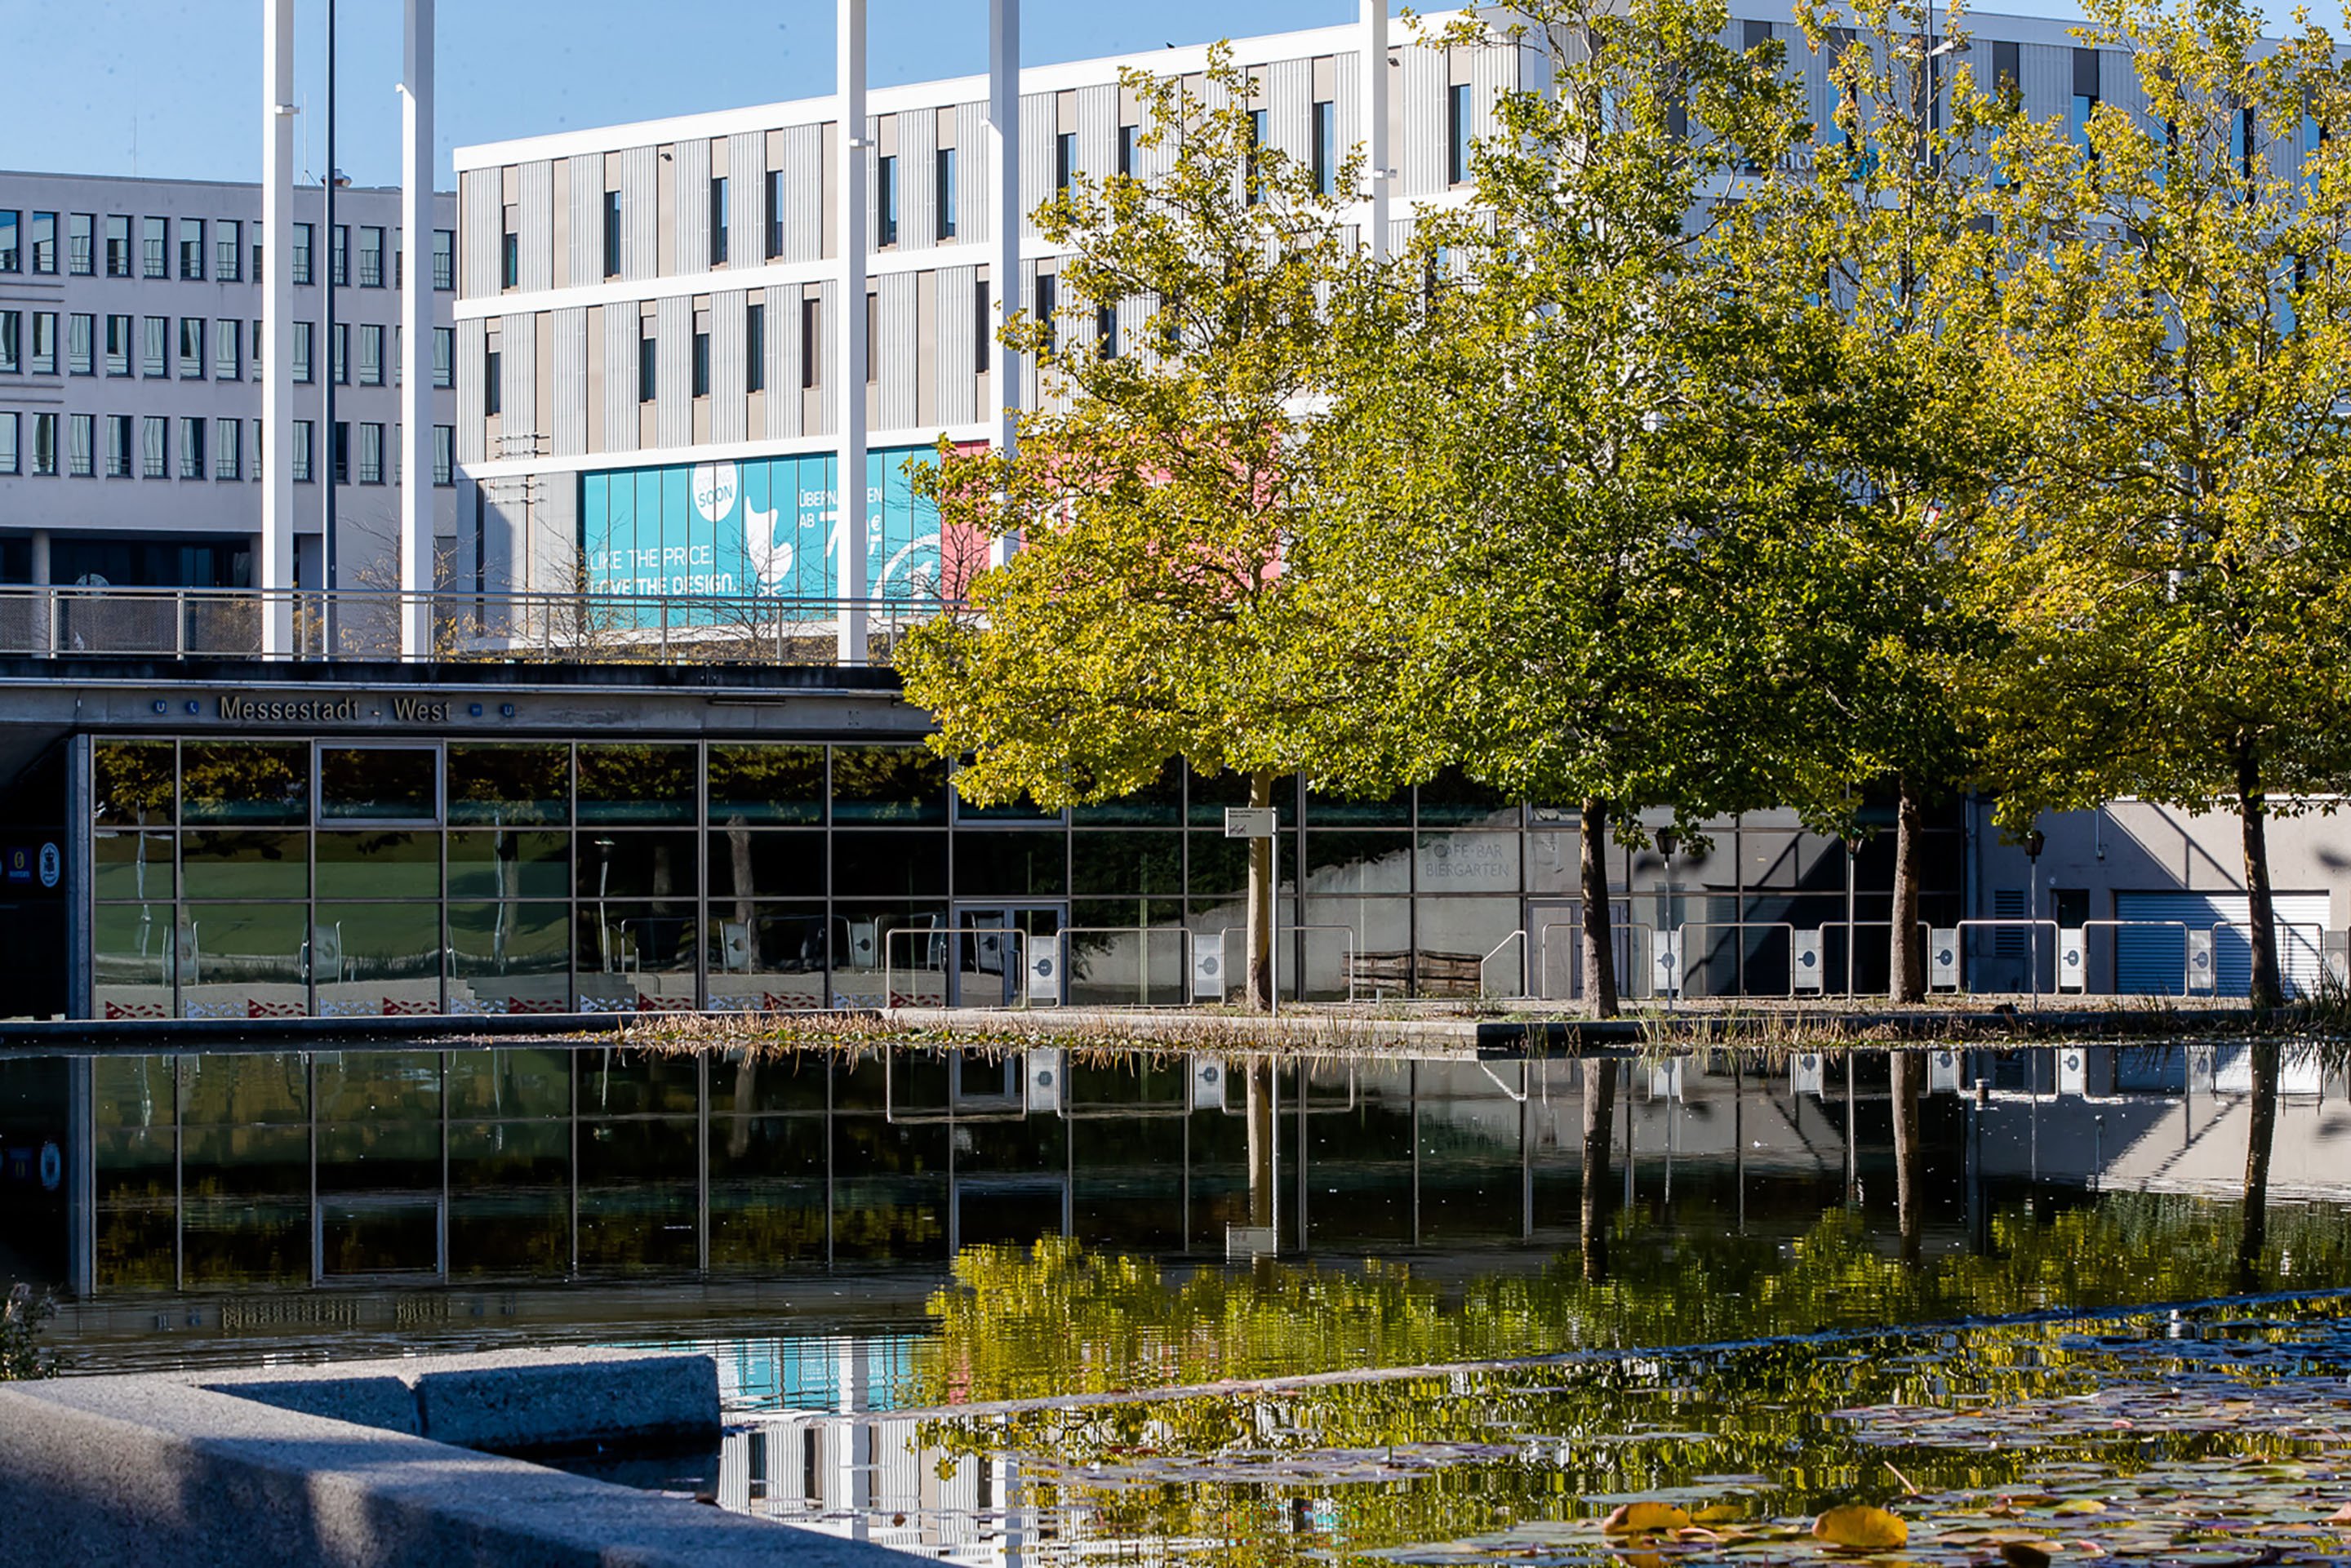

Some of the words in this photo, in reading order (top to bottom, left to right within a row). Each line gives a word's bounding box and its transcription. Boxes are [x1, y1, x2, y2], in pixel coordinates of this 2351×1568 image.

[699, 484, 732, 508] SOON
[799, 488, 882, 507] ÜBERNEN
[799, 513, 815, 528] AB
[589, 550, 622, 571] LIKE
[627, 548, 659, 568] THE
[664, 544, 714, 566] PRCE.
[636, 576, 667, 595] THE
[220, 695, 359, 722] Messestadt
[393, 697, 451, 722] West
[1425, 863, 1509, 877] BIERGARTEN
